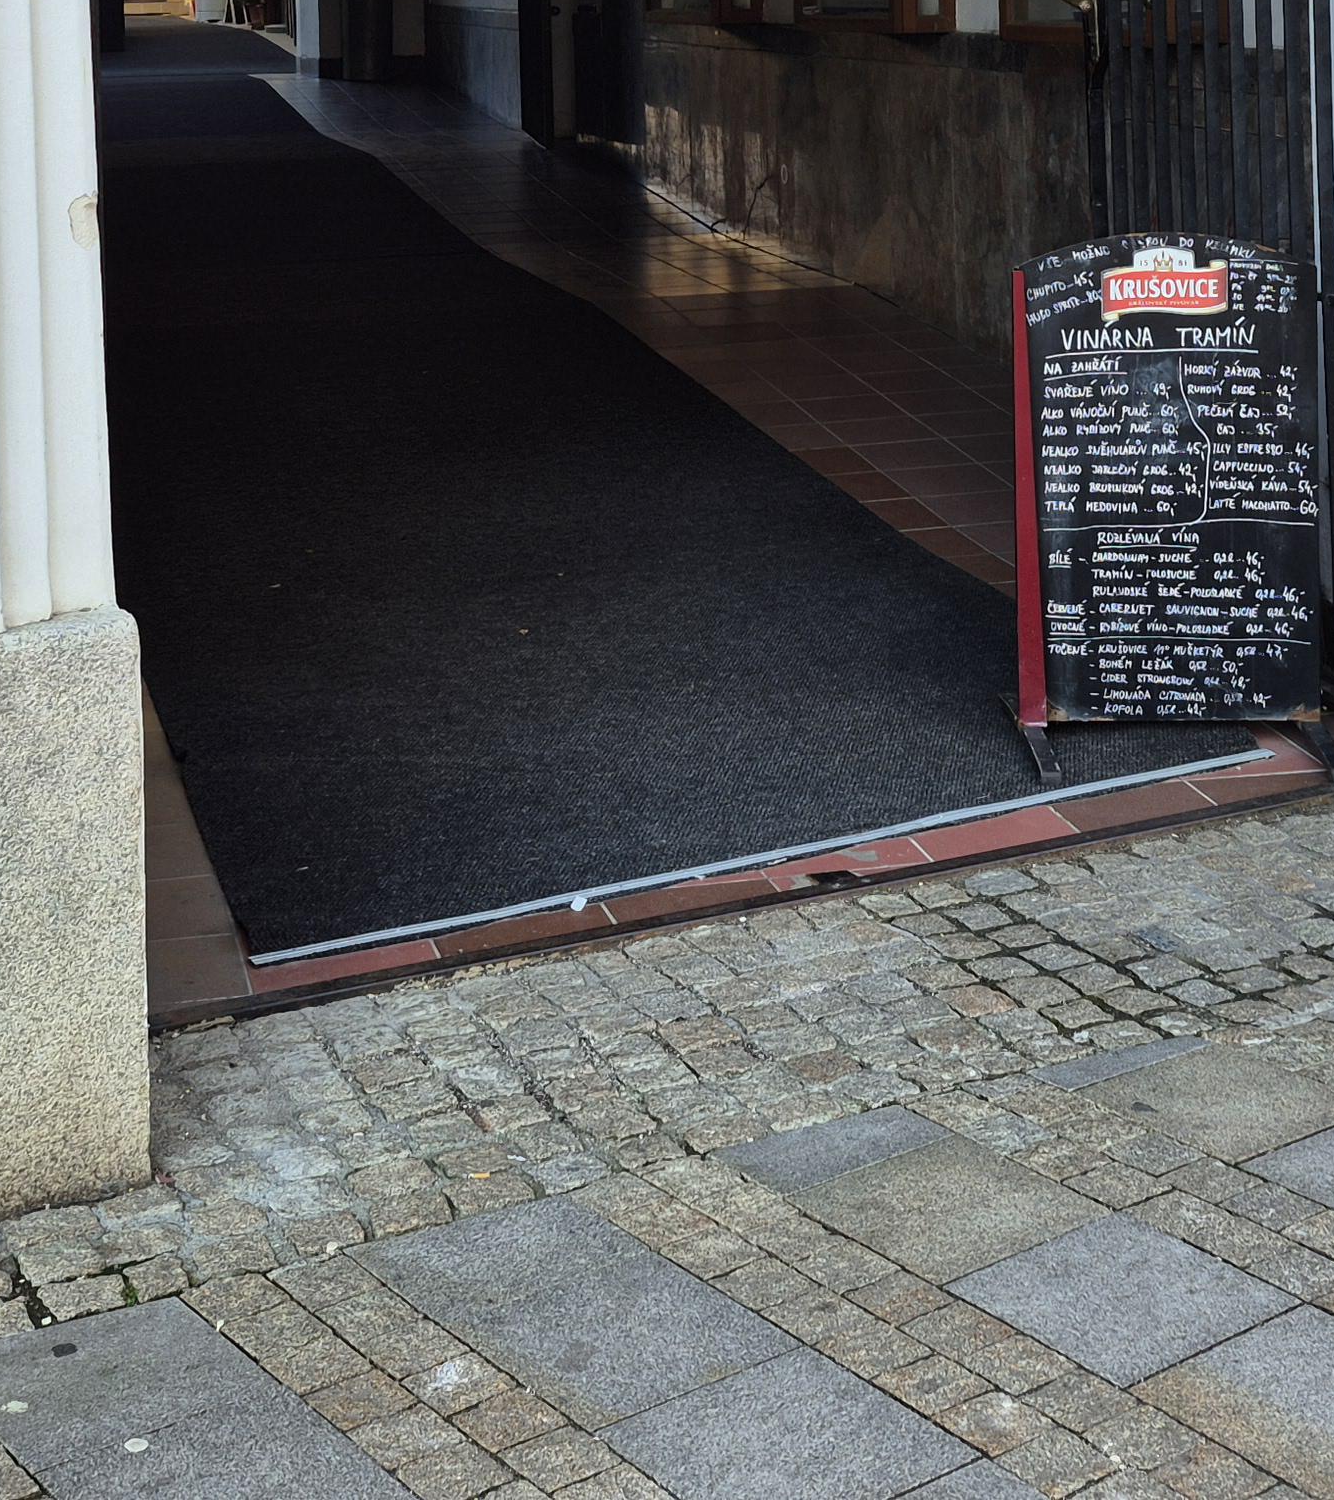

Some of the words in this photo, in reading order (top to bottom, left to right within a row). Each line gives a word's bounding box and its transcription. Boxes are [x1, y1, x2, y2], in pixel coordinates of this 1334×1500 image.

[1072, 245, 1111, 260] MOŽNO
[1179, 237, 1194, 247] DO
[1026, 281, 1066, 301] CHUPITO
[1109, 275, 1219, 301] KRUŠOVICE
[1061, 321, 1153, 350] VINÁRNA
[1176, 316, 1255, 347] TRAMÍN
[1044, 363, 1063, 375] NA
[1071, 355, 1122, 373] ZAHŘÁTÍ
[1184, 361, 1219, 376] HORKÝ
[1224, 360, 1261, 379] ZÁZVOR
[1044, 379, 1097, 398] SVAŘENÉ
[1101, 379, 1129, 396] VÍNO
[1187, 380, 1225, 395] RUMOVÝ
[1231, 385, 1256, 395] GROG
[1041, 407, 1063, 420] ALKO
[1070, 400, 1117, 419] VÁNOČNÍ
[1122, 403, 1150, 421] PUNČ
[1197, 402, 1237, 418] PEČENÝ
[1239, 404, 1259, 418] ČAJ
[1043, 425, 1067, 436] ALKO
[1217, 424, 1235, 435] ČAJ
[1042, 445, 1079, 457] NEALKO
[1152, 439, 1178, 456] PUNČ
[1213, 443, 1231, 454] ILLY
[1237, 443, 1283, 455] ESPRESSO
[1044, 465, 1082, 475] NEALKO
[1143, 465, 1167, 475] GROG
[1213, 460, 1274, 473] CAPPUCCINO
[1044, 483, 1080, 493] NEALKO
[1151, 484, 1174, 495] GROG
[1210, 474, 1257, 491] VÍDEŇSKÁ
[1262, 475, 1287, 491] KÁVA
[1045, 497, 1076, 512] TEPLÁ
[1086, 501, 1138, 514] MEDOVINA
[1209, 492, 1241, 509] LATTÉ
[1097, 528, 1163, 544] ROZLÉVANÁ
[1172, 526, 1199, 544] VÍNA
[1049, 548, 1073, 564] BÍLÉ
[1158, 548, 1196, 562] SUCHÉ
[1091, 565, 1133, 579] TRAMÍN
[1093, 581, 1150, 597] RULANDSKÉ
[1158, 582, 1185, 597] ŠEDÉ
[1047, 600, 1087, 615] ČERVENÉ
[1099, 603, 1155, 615] CABERNET
[1165, 604, 1219, 616] SAUVIGNON
[1229, 604, 1260, 618] SUCHÉ
[1051, 618, 1087, 632] OVOCNÉ
[1147, 618, 1167, 632] VÍNO
[1048, 641, 1091, 655] TOČENÉ
[1098, 640, 1148, 654] KRUŠOVICE
[1141, 656, 1173, 670] LEŽÁK
[1101, 674, 1128, 683] CIDER
[1103, 686, 1151, 700] LIMONÁDA
[1104, 702, 1143, 715] KOFOLA
